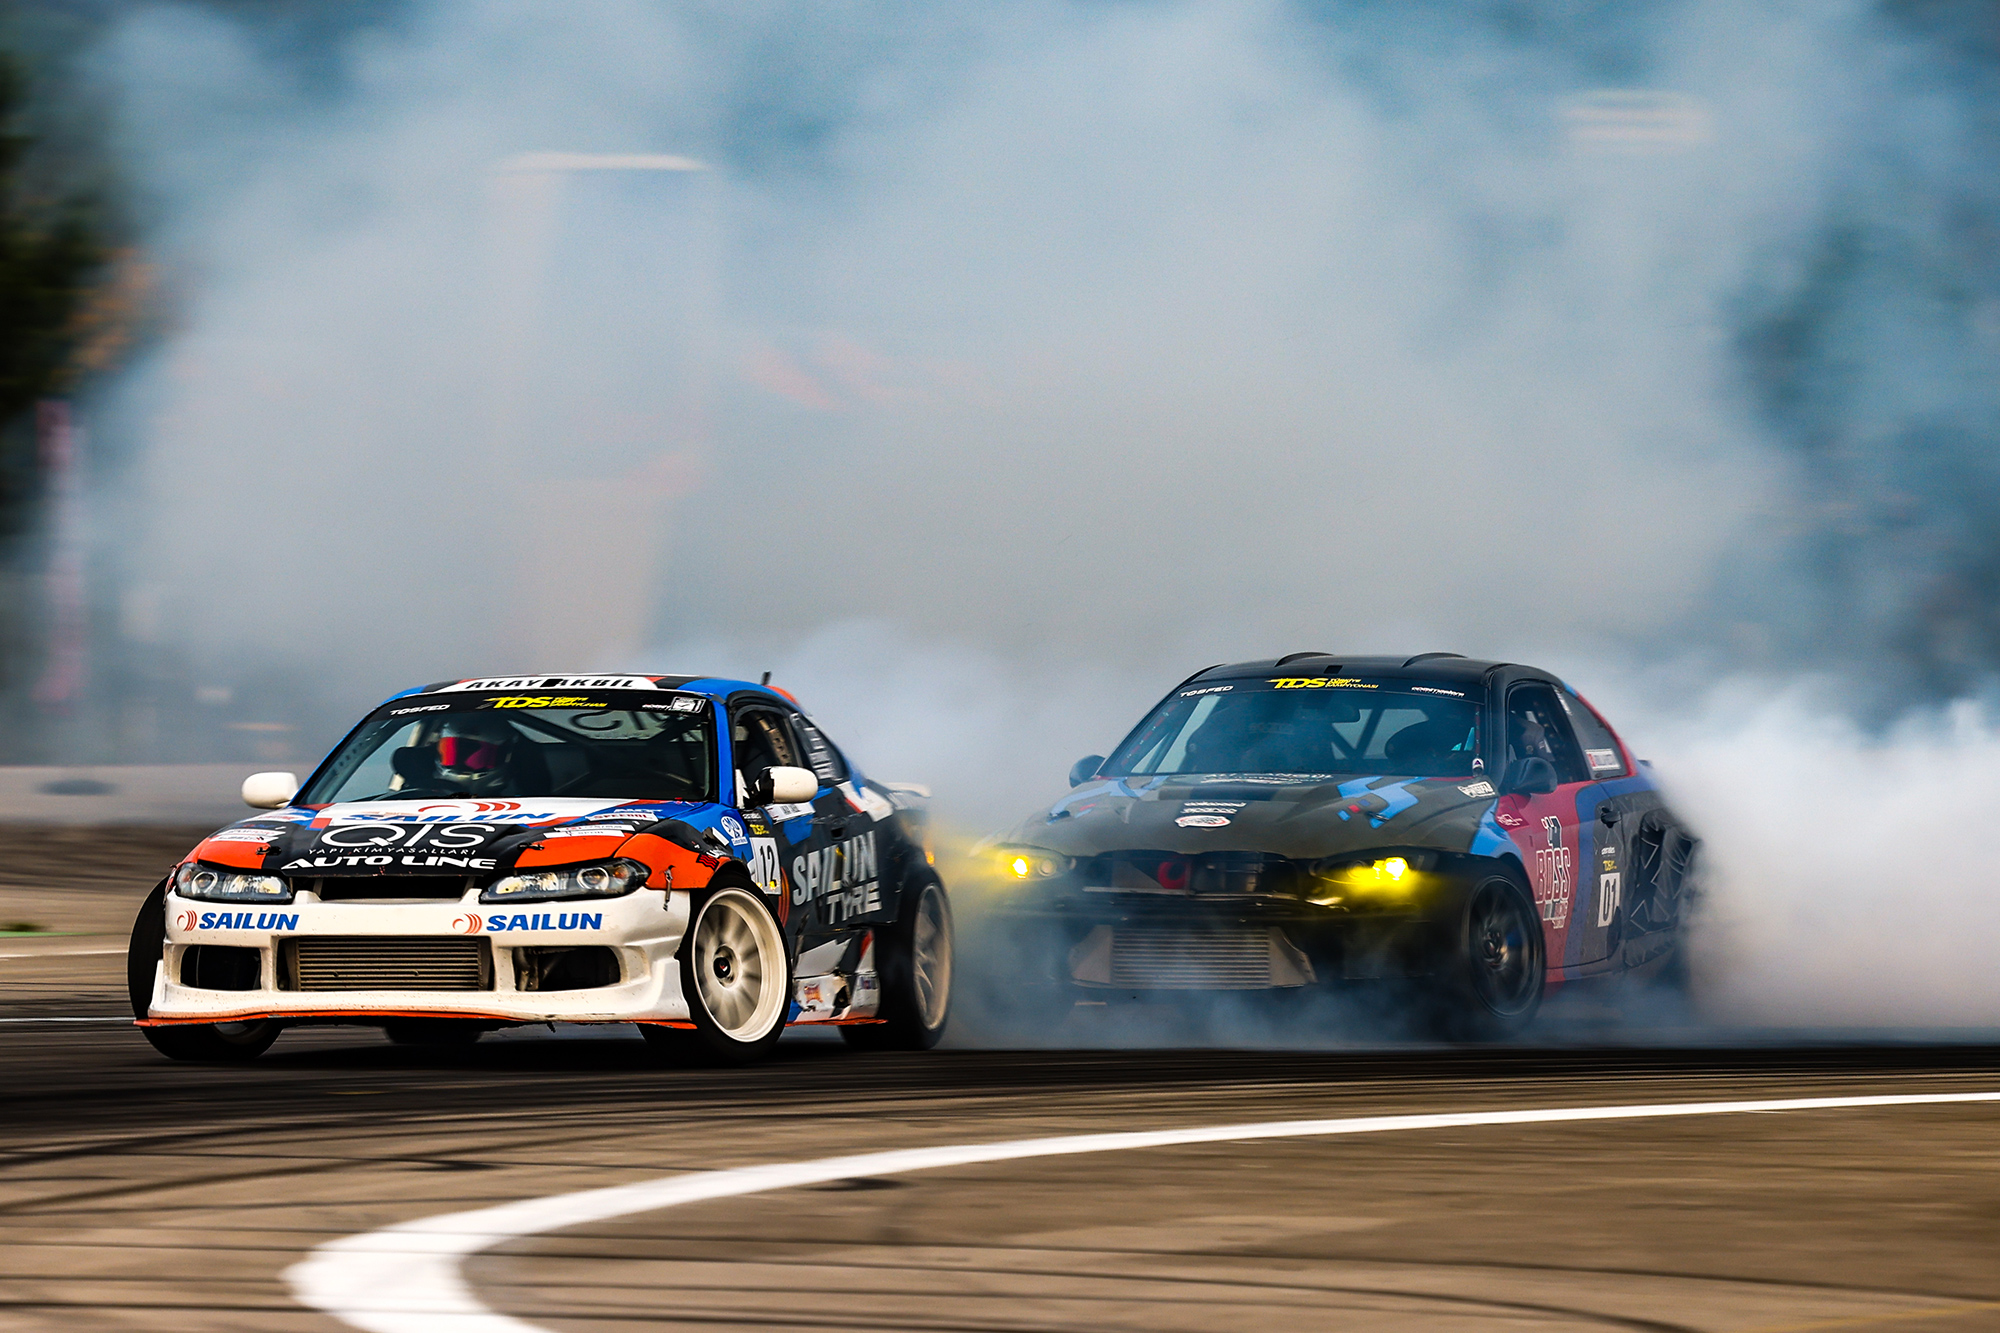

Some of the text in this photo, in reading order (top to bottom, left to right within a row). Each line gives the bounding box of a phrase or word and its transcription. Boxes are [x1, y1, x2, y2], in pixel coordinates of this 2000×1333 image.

[466, 679, 542, 689] AKAY
[1180, 685, 1234, 698] TOSFED
[1266, 677, 1328, 689] TDS
[390, 704, 451, 716] TOSFED
[484, 696, 553, 709] TDS
[342, 812, 557, 822] SAILUN
[320, 823, 496, 848] QIS
[308, 847, 344, 855] YAPI
[281, 855, 497, 870] AUTO LINE
[759, 845, 778, 887] 12
[792, 830, 878, 906] SAILUN
[1535, 846, 1571, 905] BOSS
[826, 880, 882, 925] TYRE
[1602, 878, 1618, 922] 01
[199, 912, 300, 931] SAILUN
[486, 913, 603, 932] SAILUN
